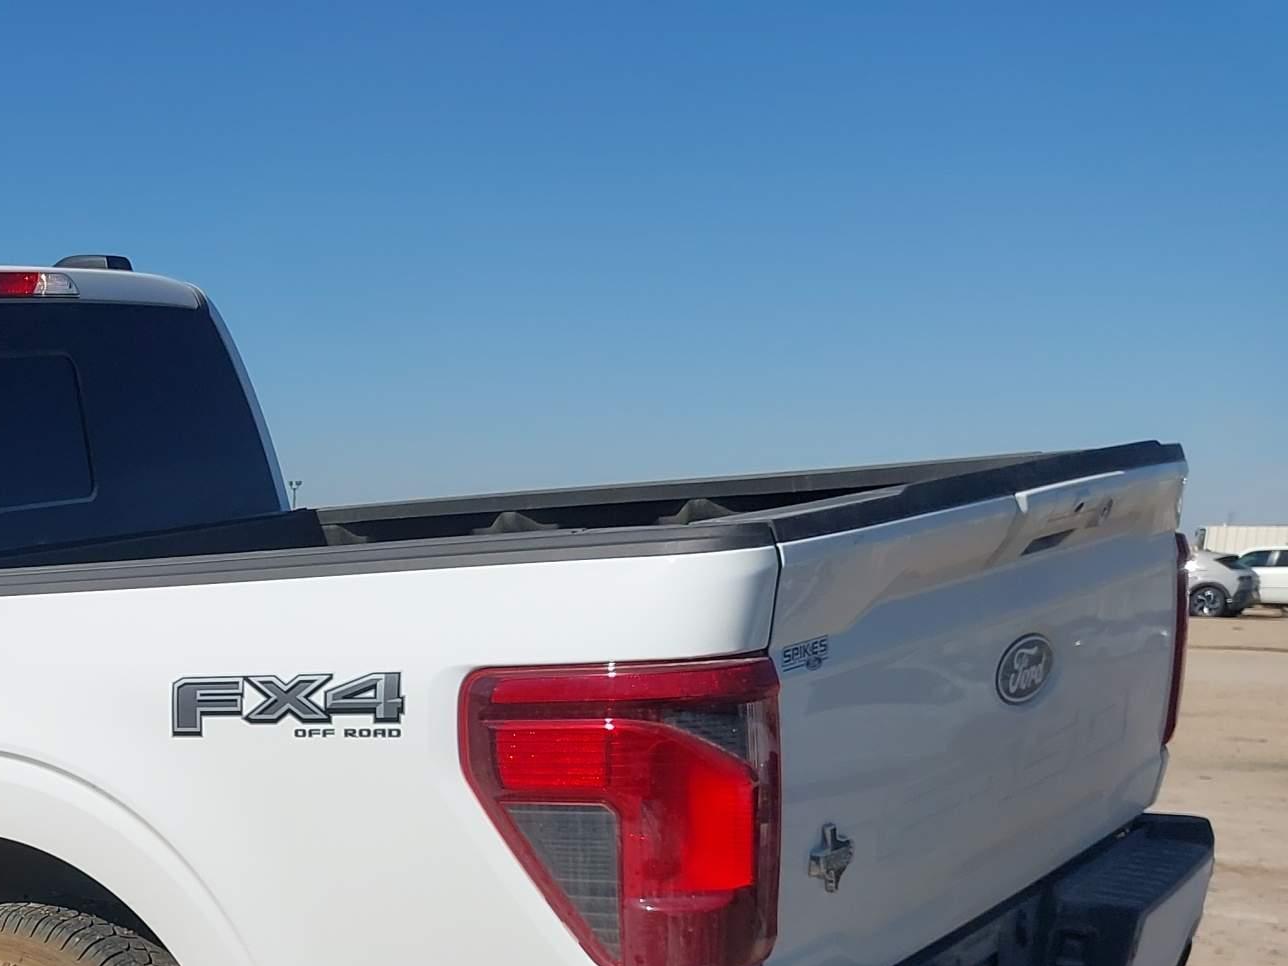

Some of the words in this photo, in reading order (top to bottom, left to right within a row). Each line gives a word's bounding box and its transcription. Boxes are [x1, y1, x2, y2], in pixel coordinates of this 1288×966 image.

[782, 638, 828, 664] SPIKES
[1009, 645, 1046, 694] Ford
[171, 671, 405, 738] FX4
[293, 728, 335, 738] OFF
[343, 728, 402, 738] ROAD
